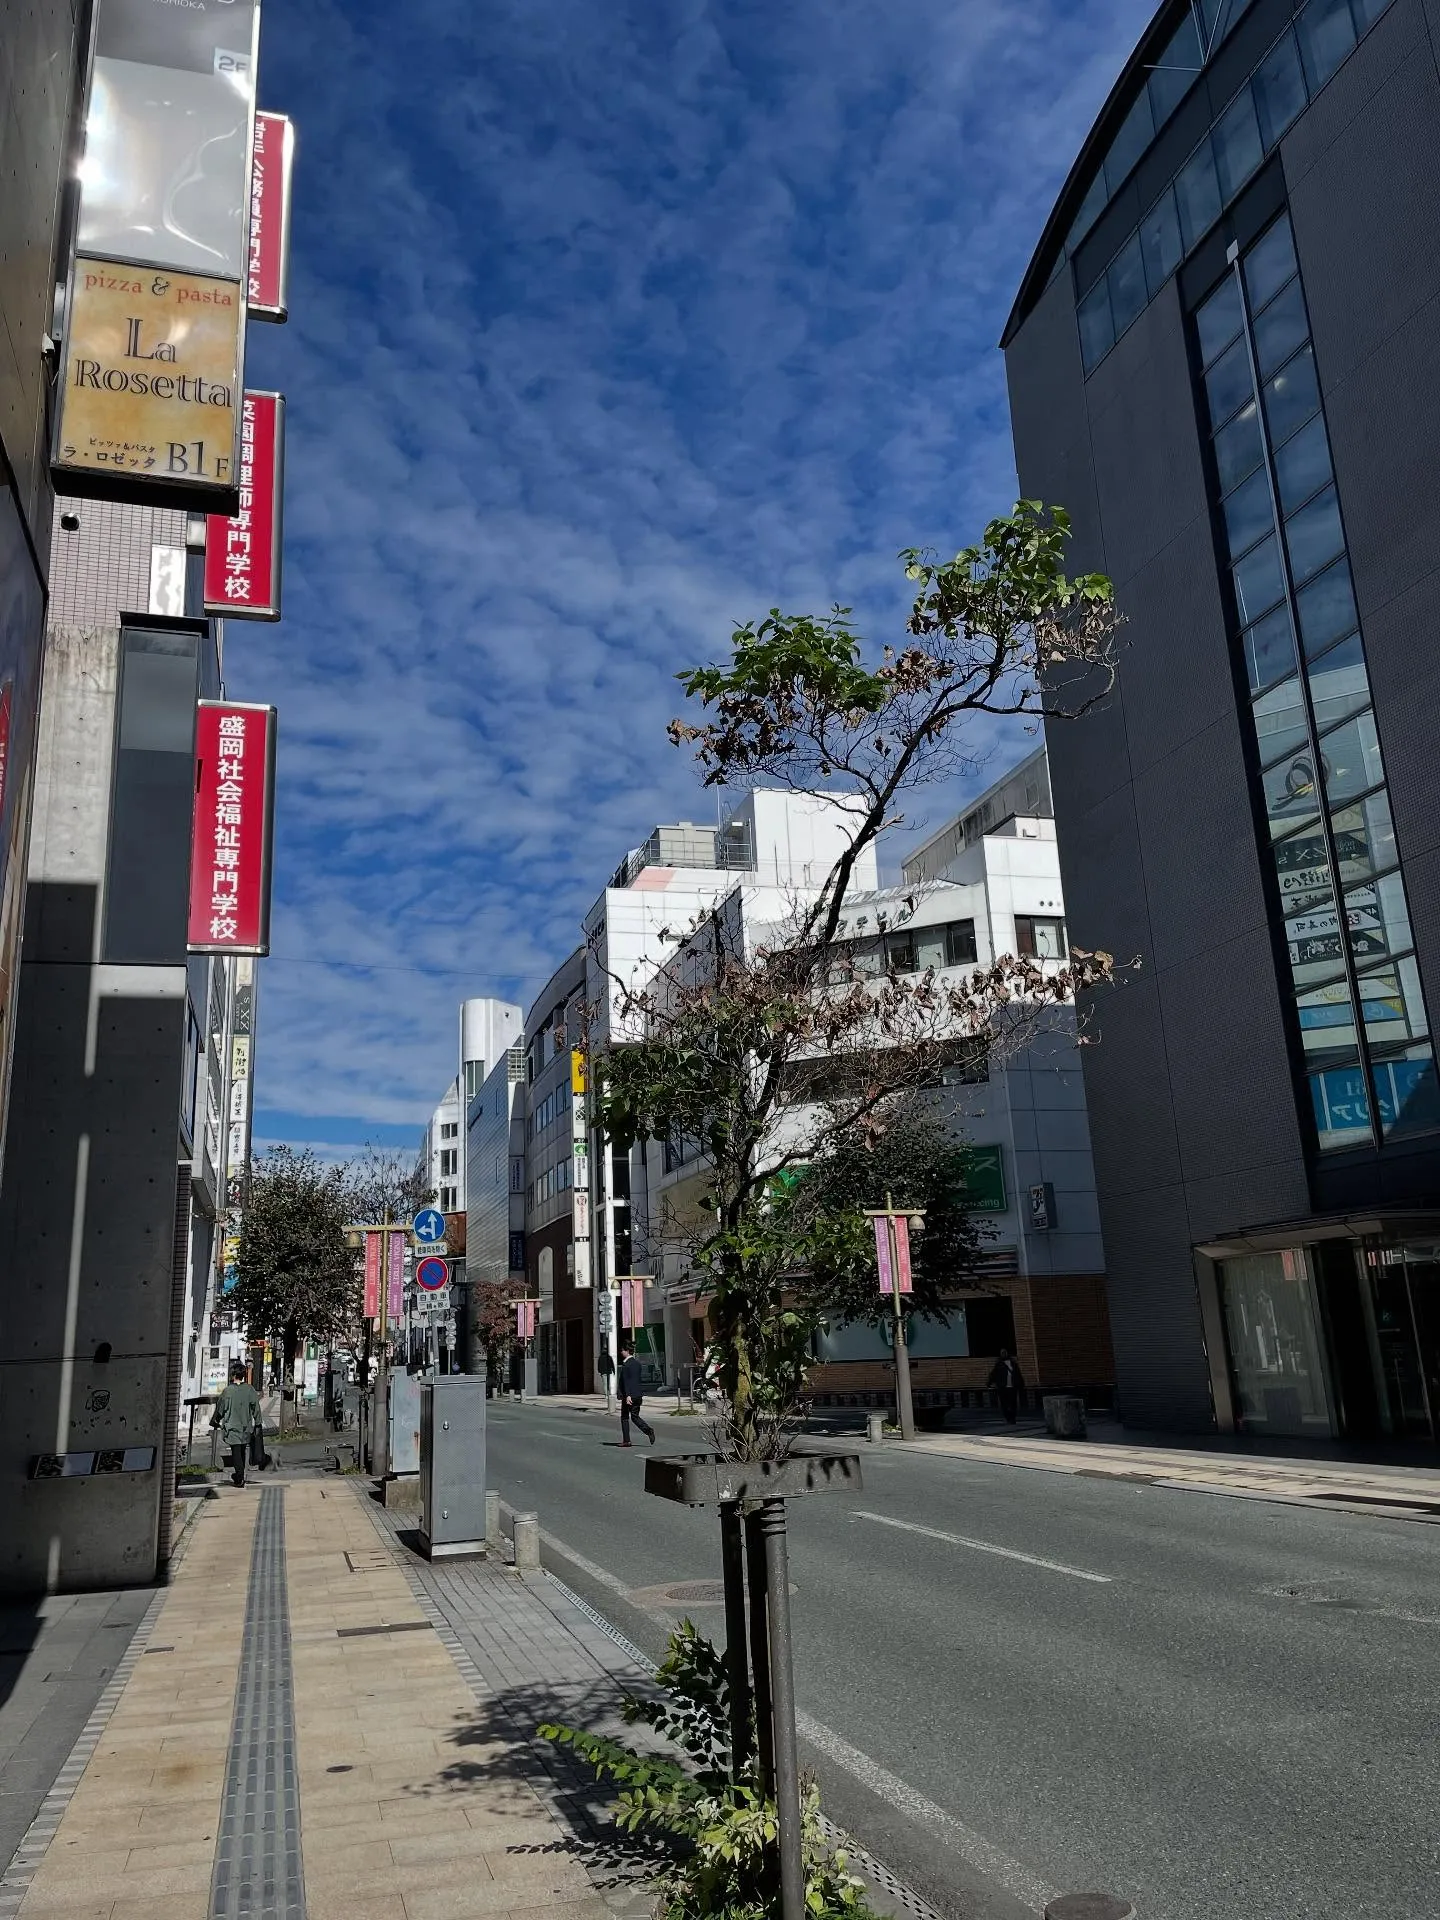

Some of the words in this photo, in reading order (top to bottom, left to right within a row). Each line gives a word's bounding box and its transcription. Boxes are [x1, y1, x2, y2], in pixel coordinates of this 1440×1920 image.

[218, 55, 247, 73] 2F
[85, 270, 144, 294] pizza
[151, 276, 171, 298] &
[176, 284, 233, 307] pasta
[124, 317, 178, 364] La
[74, 359, 233, 408] Rosetta
[63, 445, 156, 469] ラ・ロゼッタ
[209, 715, 246, 941] 盛岡社会福祉専門学校
[393, 1236, 401, 1260] CINEMA
[392, 1264, 400, 1286] STREET
